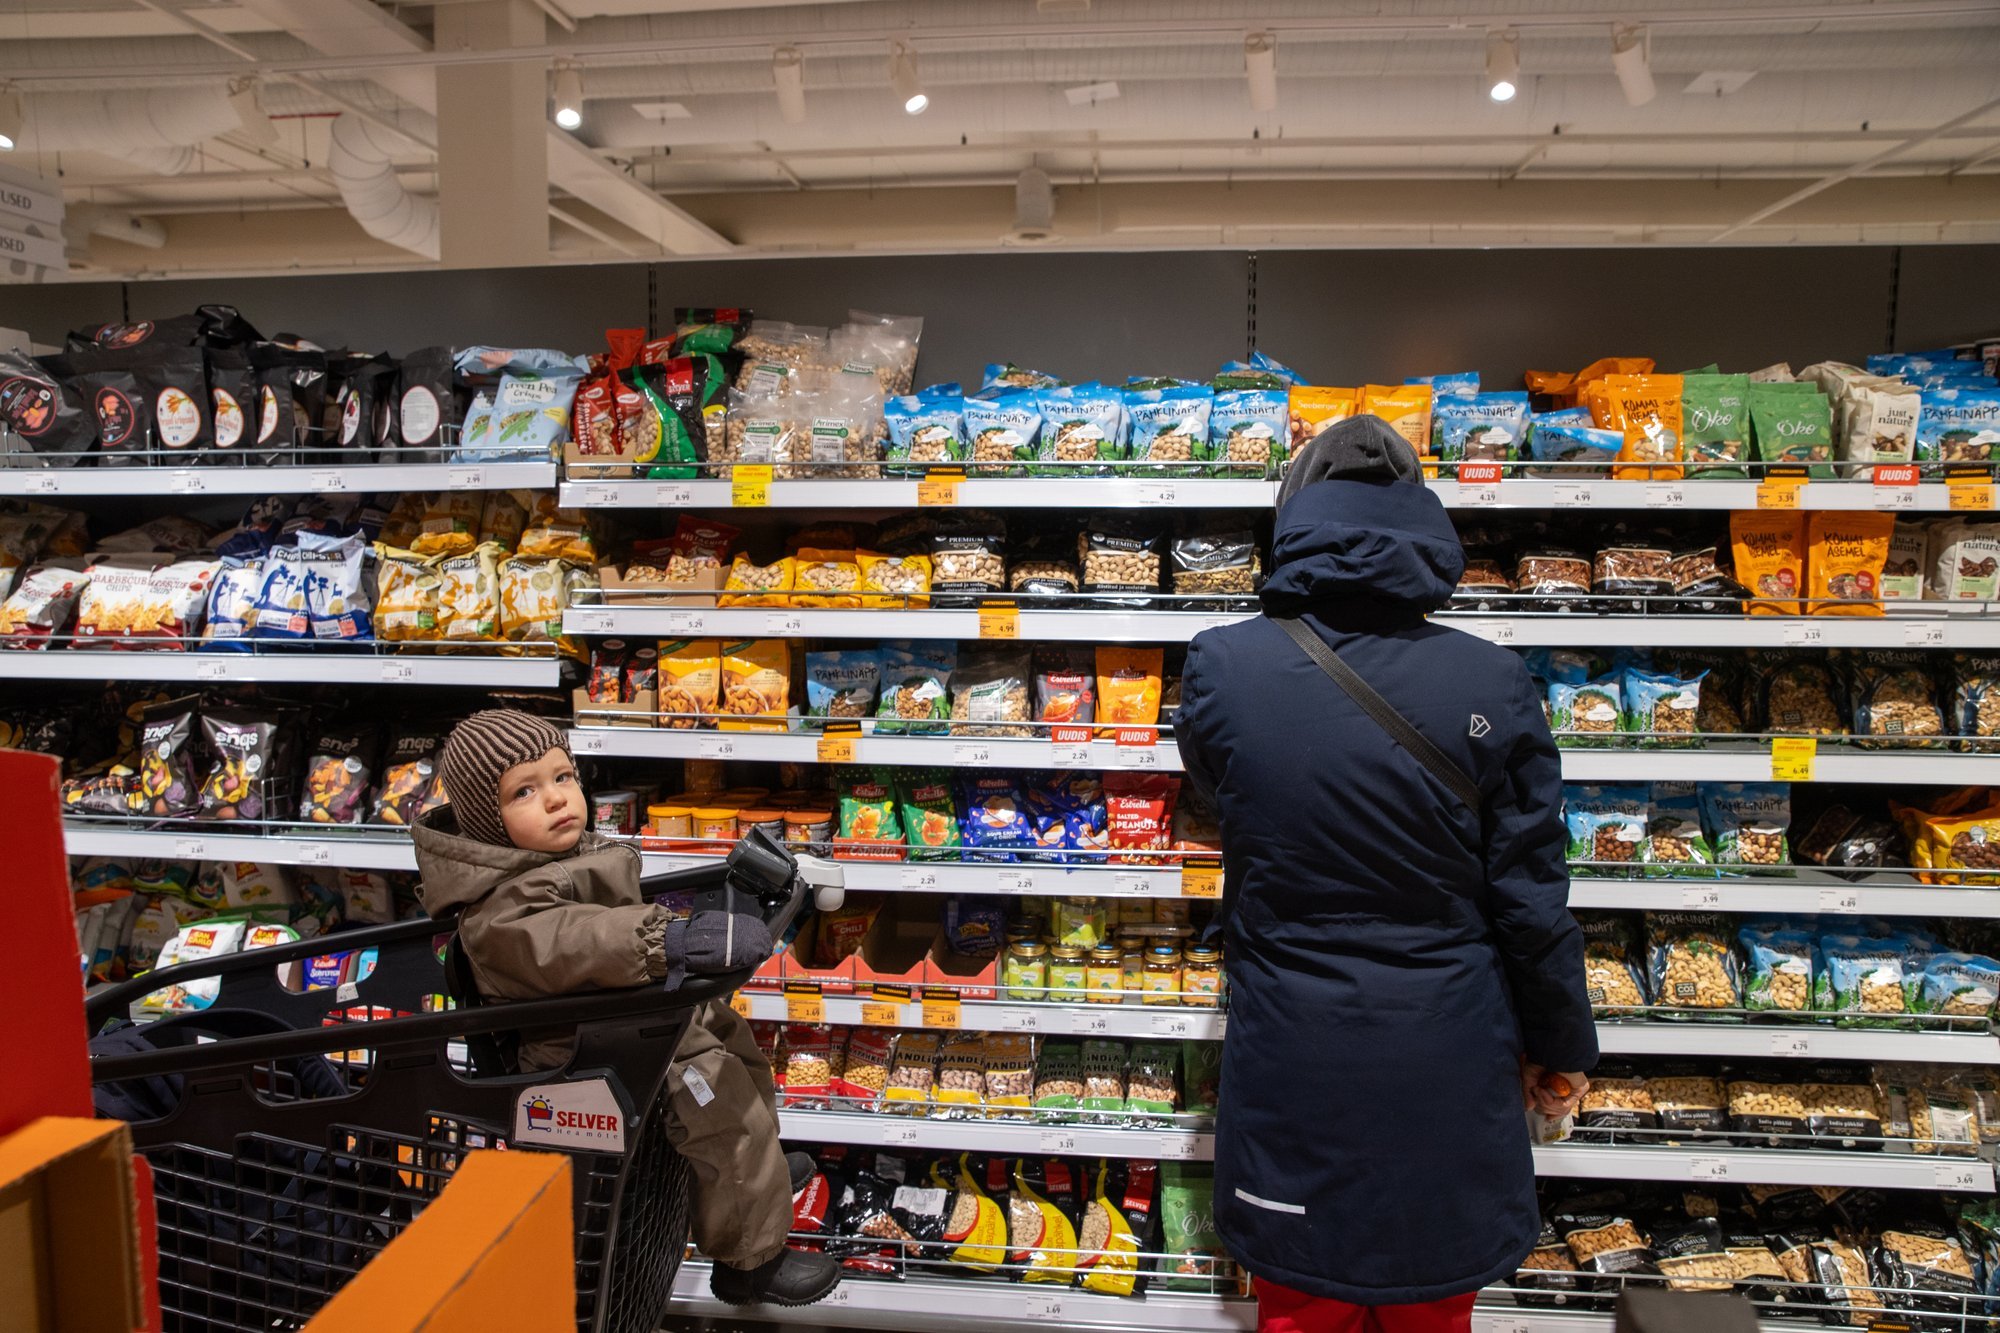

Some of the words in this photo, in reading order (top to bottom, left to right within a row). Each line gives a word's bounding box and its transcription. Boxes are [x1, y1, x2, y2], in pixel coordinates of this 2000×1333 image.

[846, 363, 874, 373] Arimex
[1298, 400, 1338, 410] Seeberger
[1887, 408, 1907, 418] just
[815, 419, 845, 428] Arimex
[1691, 406, 1735, 433] Öko
[1878, 416, 1914, 428] nature
[1776, 419, 1817, 436] Öko
[1464, 468, 1496, 480] UUDIS
[1880, 470, 1913, 481] UUDIS
[751, 493, 766, 501] 4.99
[937, 492, 953, 500] 3.49
[1159, 493, 1175, 501] 4.29
[1479, 493, 1496, 502] 4.19
[1574, 493, 1591, 502] 4.99
[1666, 494, 1683, 503] 5.99
[1778, 494, 1795, 503] 3.39
[1896, 494, 1913, 503] 7.49
[1971, 494, 1989, 504] 3.59
[949, 536, 985, 544] PREMIUM
[1824, 532, 1863, 547] KOMMI
[1974, 533, 1995, 545] just
[1106, 539, 1142, 551] PREMIUM
[1827, 547, 1866, 558] ASEMEL
[599, 621, 614, 629] 7.99
[688, 621, 703, 629] 5.29
[785, 622, 800, 630] 4.79
[999, 624, 1014, 632] 4.99
[1804, 631, 1820, 640] 3.19
[1926, 632, 1942, 641] 7.49
[1050, 675, 1082, 683] Estrella
[1057, 731, 1087, 742] UUDIS
[1120, 732, 1150, 742] UUDIS
[718, 745, 733, 754] 4.59
[836, 749, 851, 757] 1.39
[973, 752, 989, 761] 3.69
[1072, 752, 1087, 760] 2.29
[1139, 756, 1155, 764] 2.29
[1792, 767, 1809, 776] 6.49
[916, 789, 945, 800] Estrella
[1120, 800, 1150, 809] Estrella
[1116, 820, 1157, 831] PEANUTS
[920, 877, 935, 885] 2.29
[1017, 880, 1032, 888] 2.29
[1134, 883, 1149, 891] 2.29
[1200, 885, 1216, 893] 5.49
[1702, 896, 1718, 904] 3.99
[1839, 899, 1856, 908] 4.89
[1677, 985, 1694, 994] CO2
[1588, 990, 1603, 1000] CO2
[806, 1008, 820, 1017] 1.69
[881, 1012, 895, 1020] 1.69
[941, 1015, 956, 1024] 1.69
[1021, 1018, 1036, 1027] 3.99
[1091, 1021, 1106, 1030] 3.99
[1170, 1025, 1186, 1034] 3.99
[1792, 1042, 1808, 1051] 4.79
[556, 1111, 618, 1131] SELVER
[557, 1128, 580, 1136] Hea
[902, 1132, 917, 1140] 2.59
[1059, 1141, 1074, 1149] 3.19
[1180, 1146, 1195, 1155] 1.29
[1711, 1165, 1727, 1175] 6.29
[1956, 1175, 1973, 1185] 3.69
[1125, 1200, 1147, 1211] SELVER
[1674, 1236, 1708, 1250] PREMIUM
[833, 1291, 848, 1300] 1.69
[1046, 1305, 1061, 1314] 1.69
